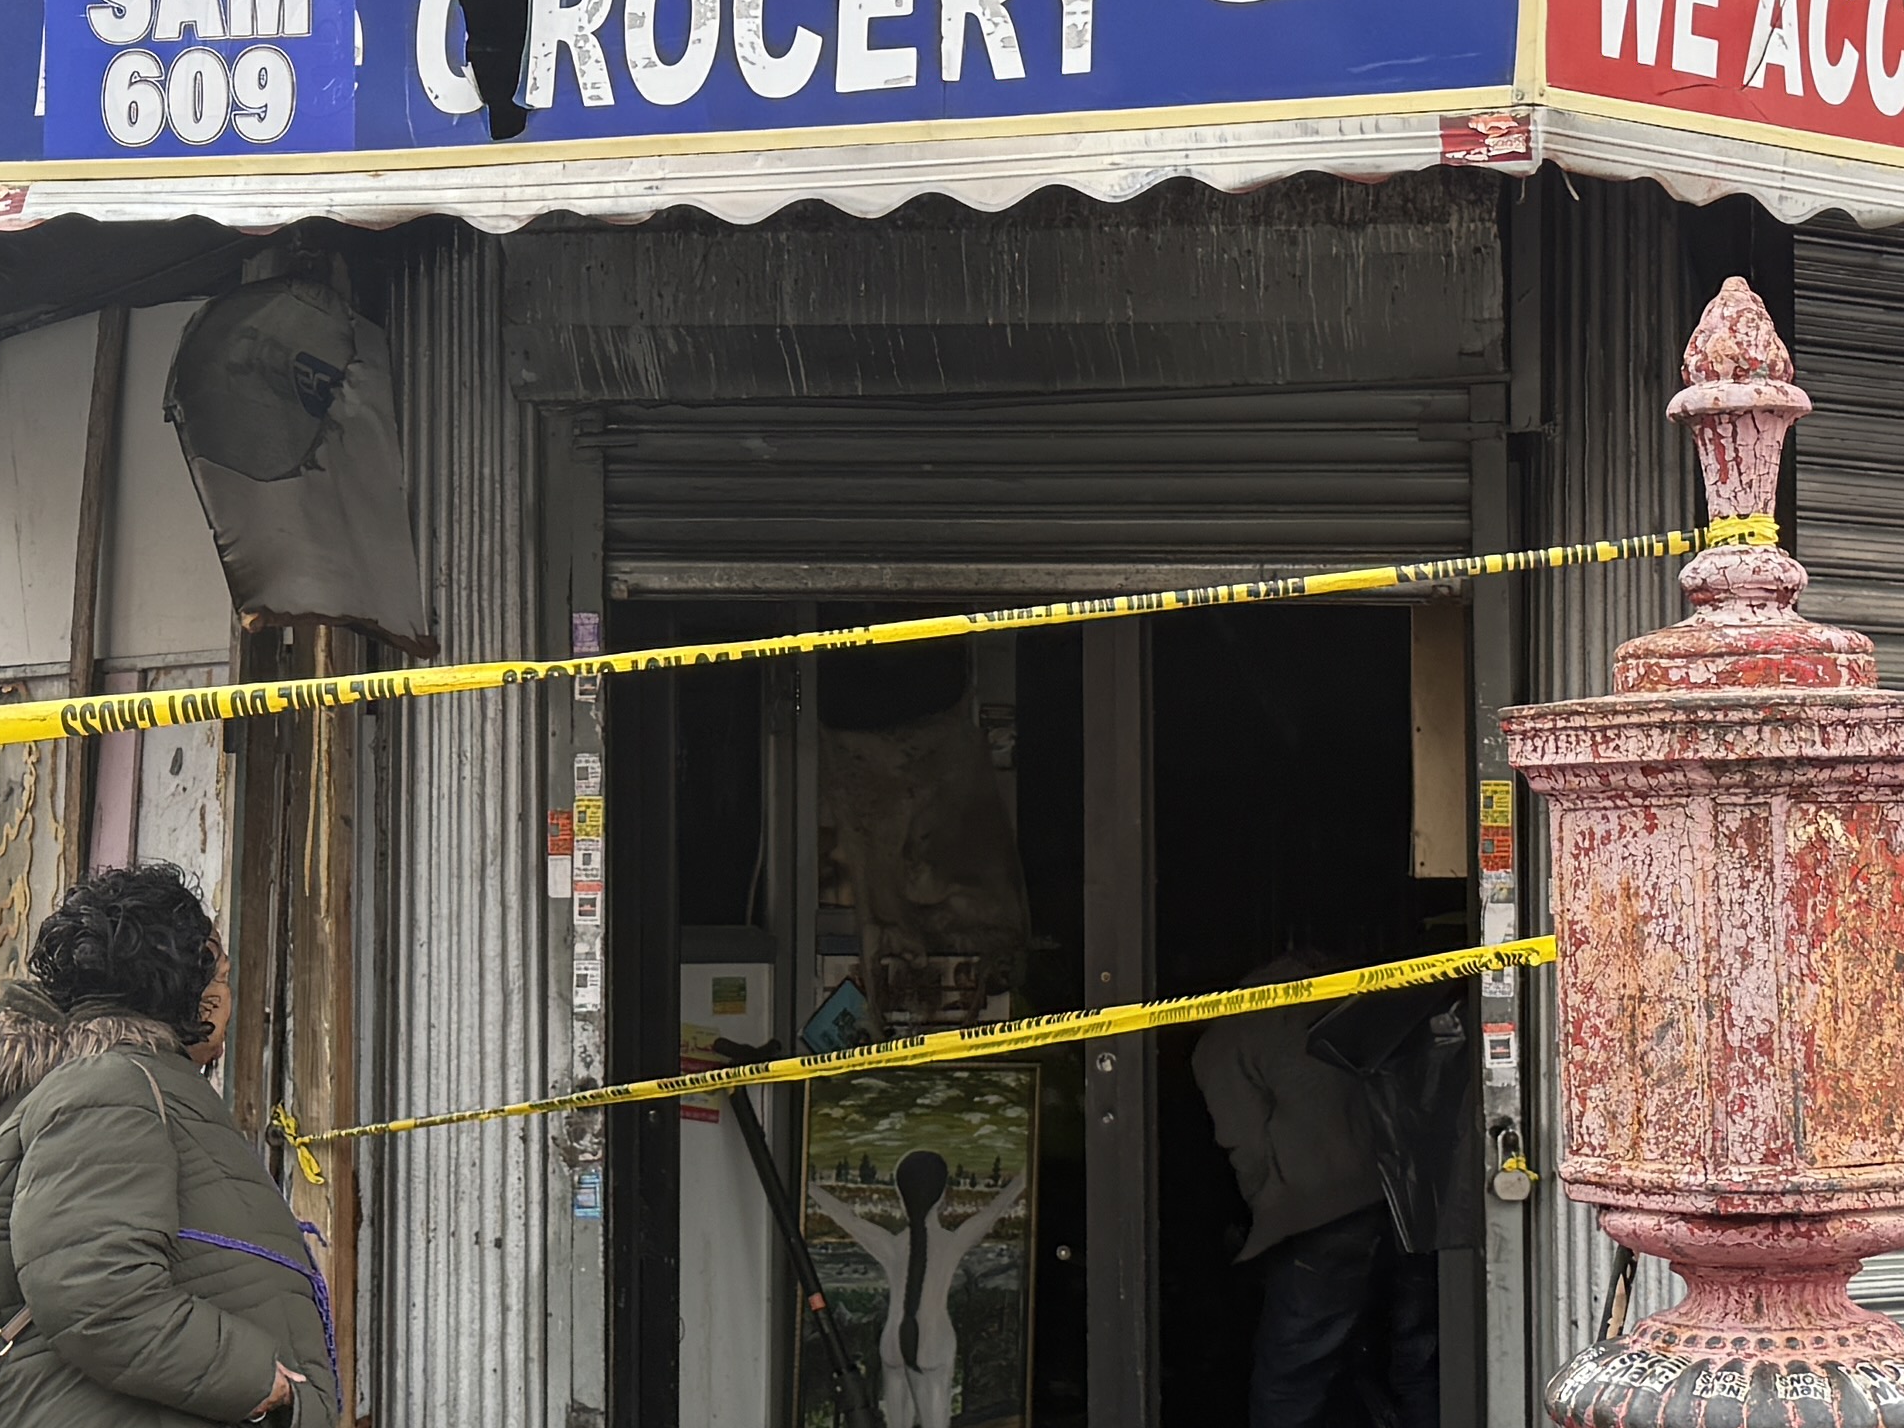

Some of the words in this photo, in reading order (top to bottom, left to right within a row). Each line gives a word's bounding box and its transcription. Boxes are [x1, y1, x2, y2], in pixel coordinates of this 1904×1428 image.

[100, 43, 298, 148] 609
[59, 697, 158, 738] CROSS
[168, 690, 223, 726] NOT
